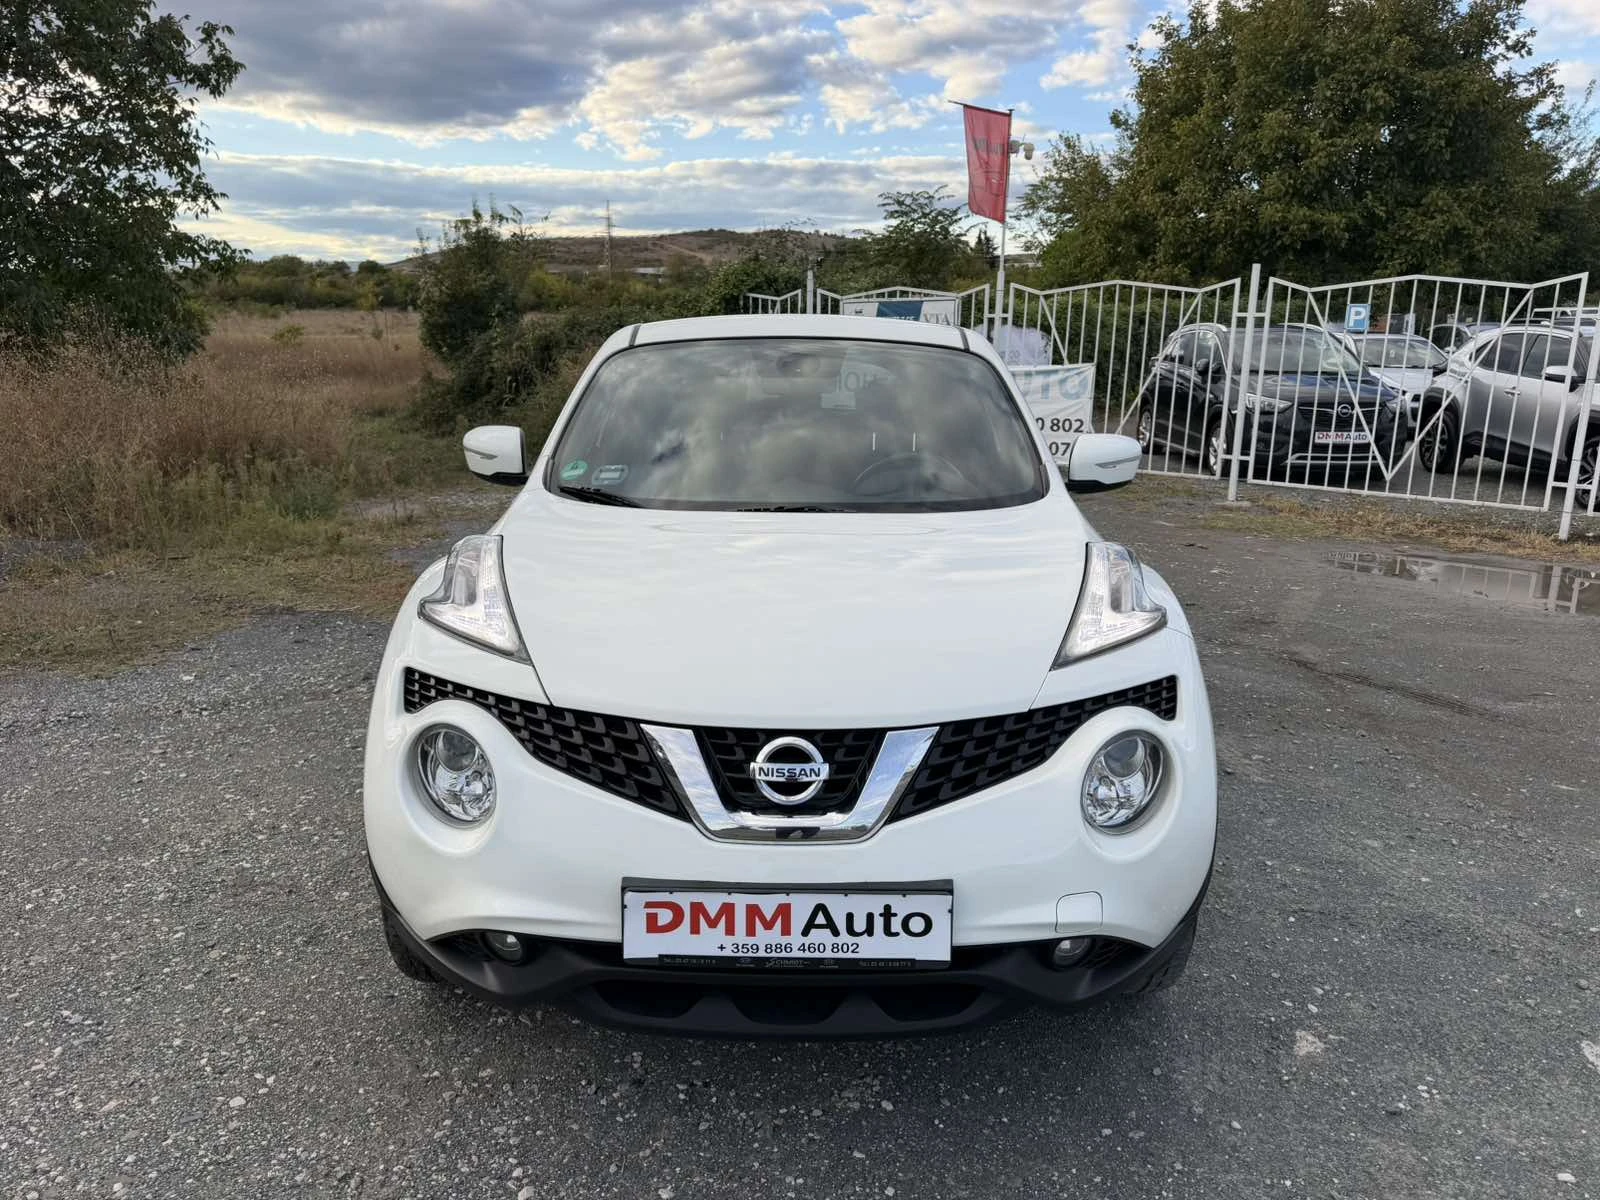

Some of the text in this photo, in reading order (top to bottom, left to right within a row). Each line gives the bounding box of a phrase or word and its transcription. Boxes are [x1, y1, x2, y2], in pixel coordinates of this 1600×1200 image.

[1349, 307, 1366, 327] P
[1050, 418, 1084, 433] 802
[758, 767, 821, 778] NISSAN
[731, 942, 759, 955] 359
[764, 942, 793, 954] 886
[797, 942, 826, 954] 460
[831, 942, 860, 954] 802
